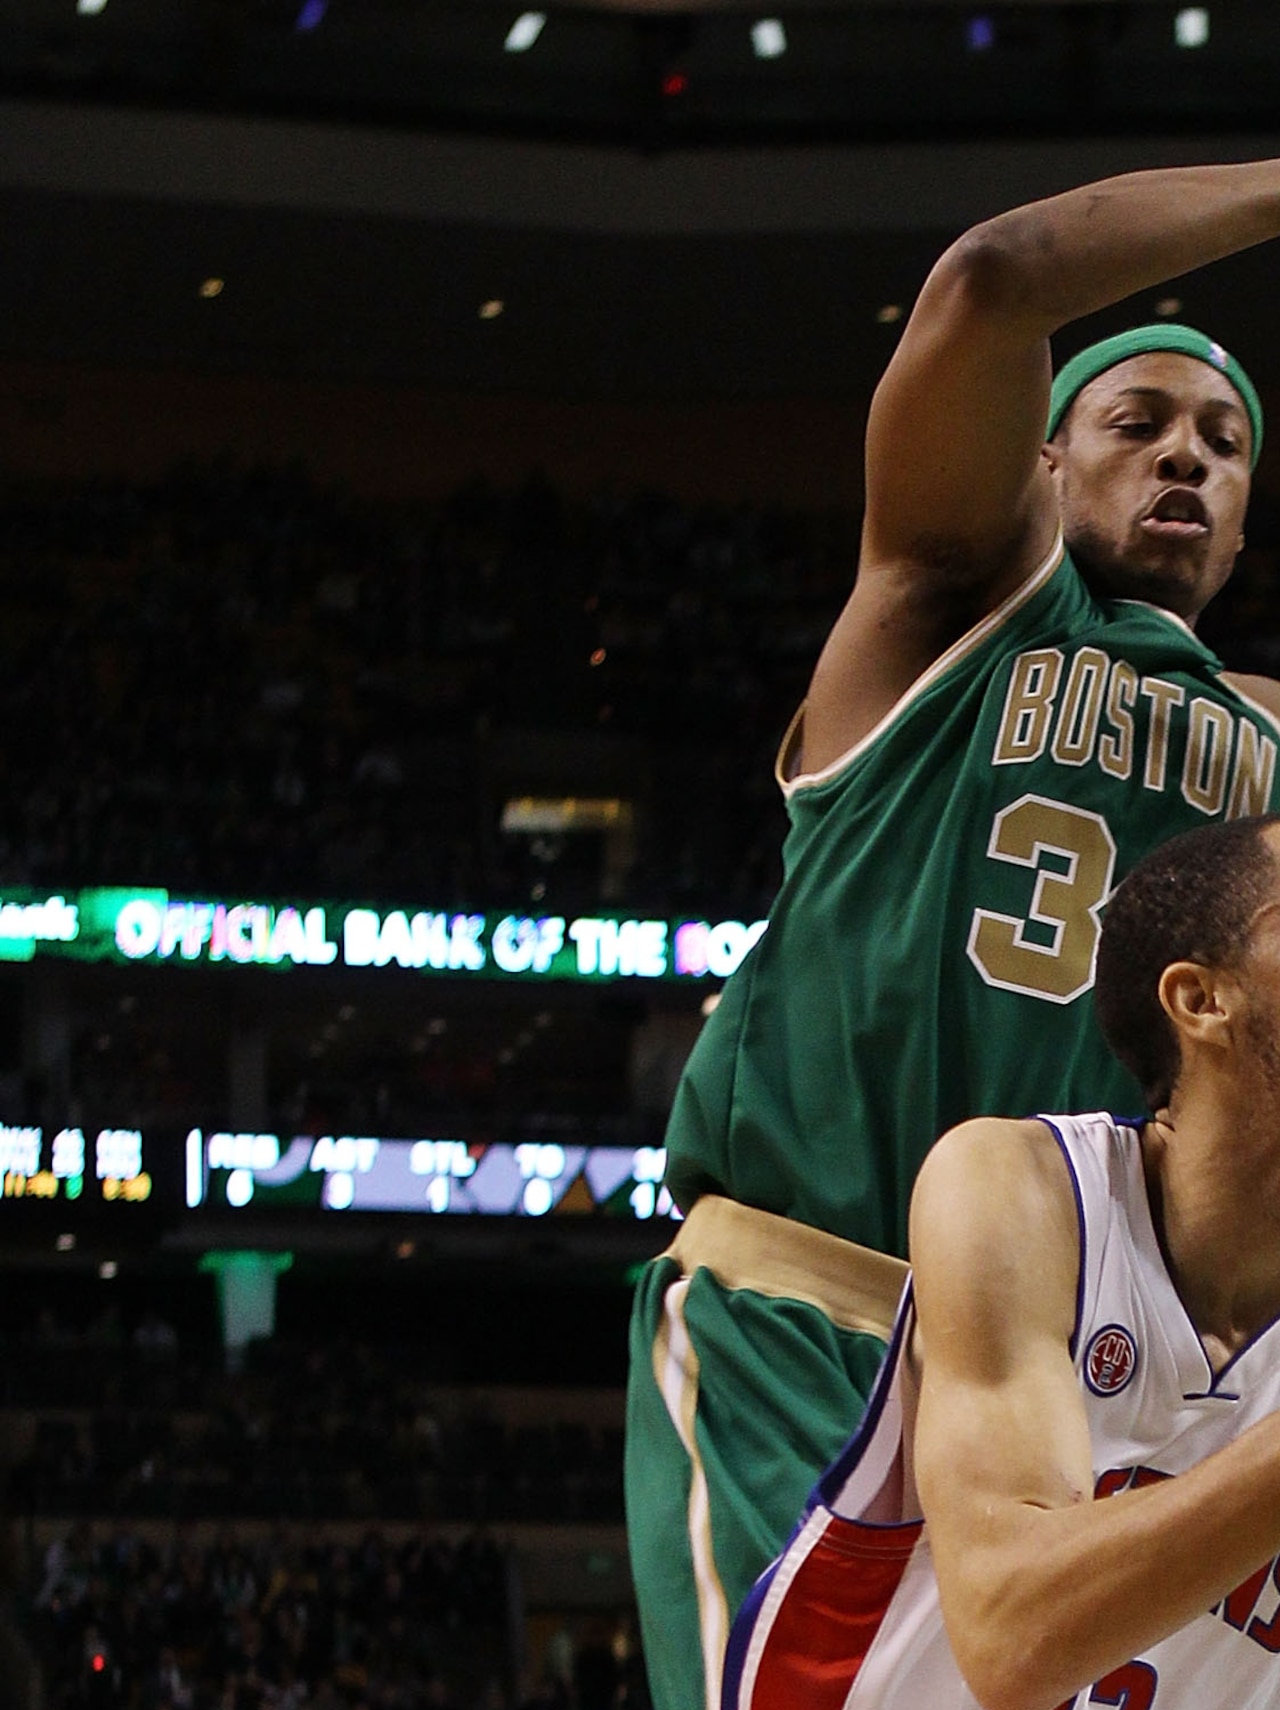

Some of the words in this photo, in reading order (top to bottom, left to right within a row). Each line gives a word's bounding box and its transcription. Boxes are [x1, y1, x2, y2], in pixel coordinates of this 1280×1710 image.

[991, 646, 1277, 821] BOSTON
[115, 899, 338, 965] OFFICIAL
[344, 908, 486, 971] BANK
[492, 914, 565, 974] OF
[569, 917, 668, 977] THE
[966, 793, 1117, 1005] 3
